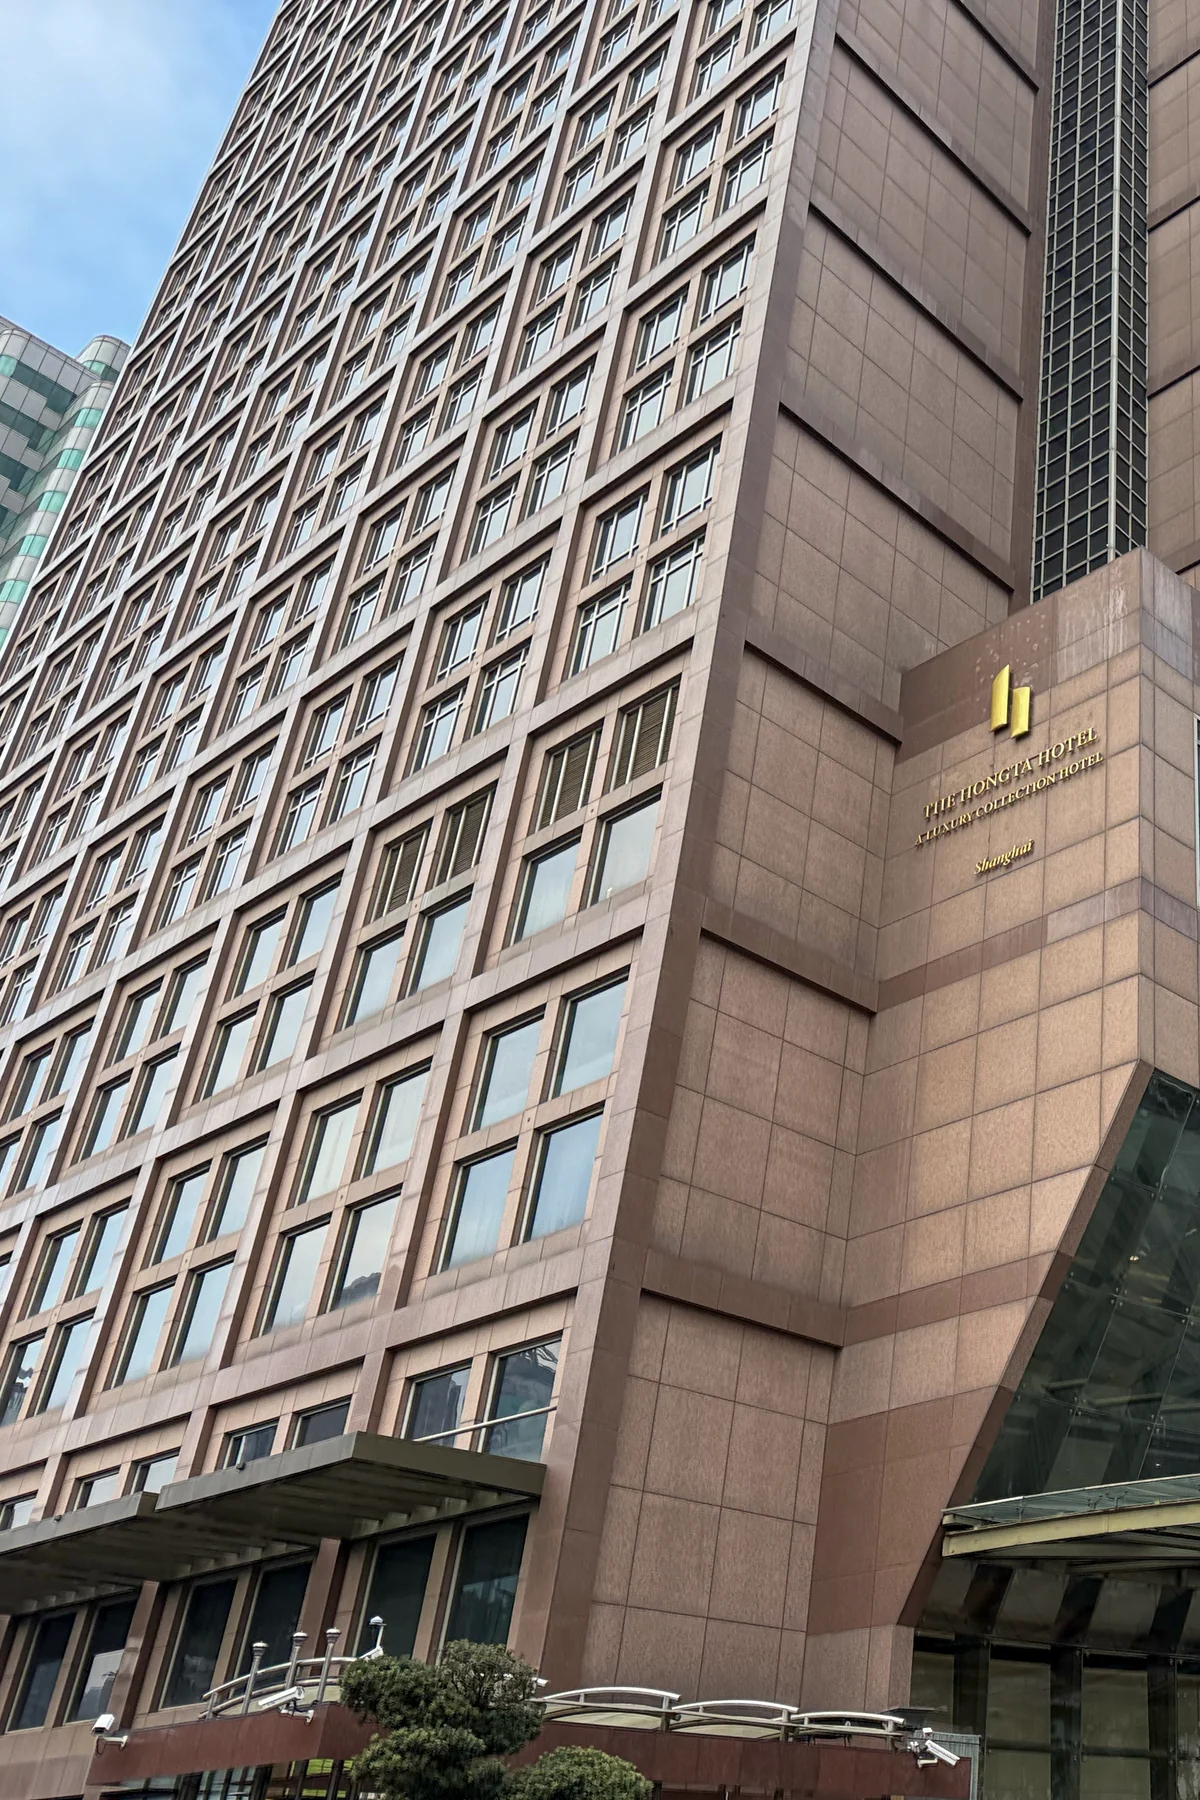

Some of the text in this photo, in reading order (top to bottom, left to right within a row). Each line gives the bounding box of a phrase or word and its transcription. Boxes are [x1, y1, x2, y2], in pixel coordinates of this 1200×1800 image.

[914, 752, 1104, 847] A LUXURY COLLECTION HOTEL
[923, 726, 1098, 820] THE HONGTA HOTEL
[973, 838, 1034, 875] Shanghai
